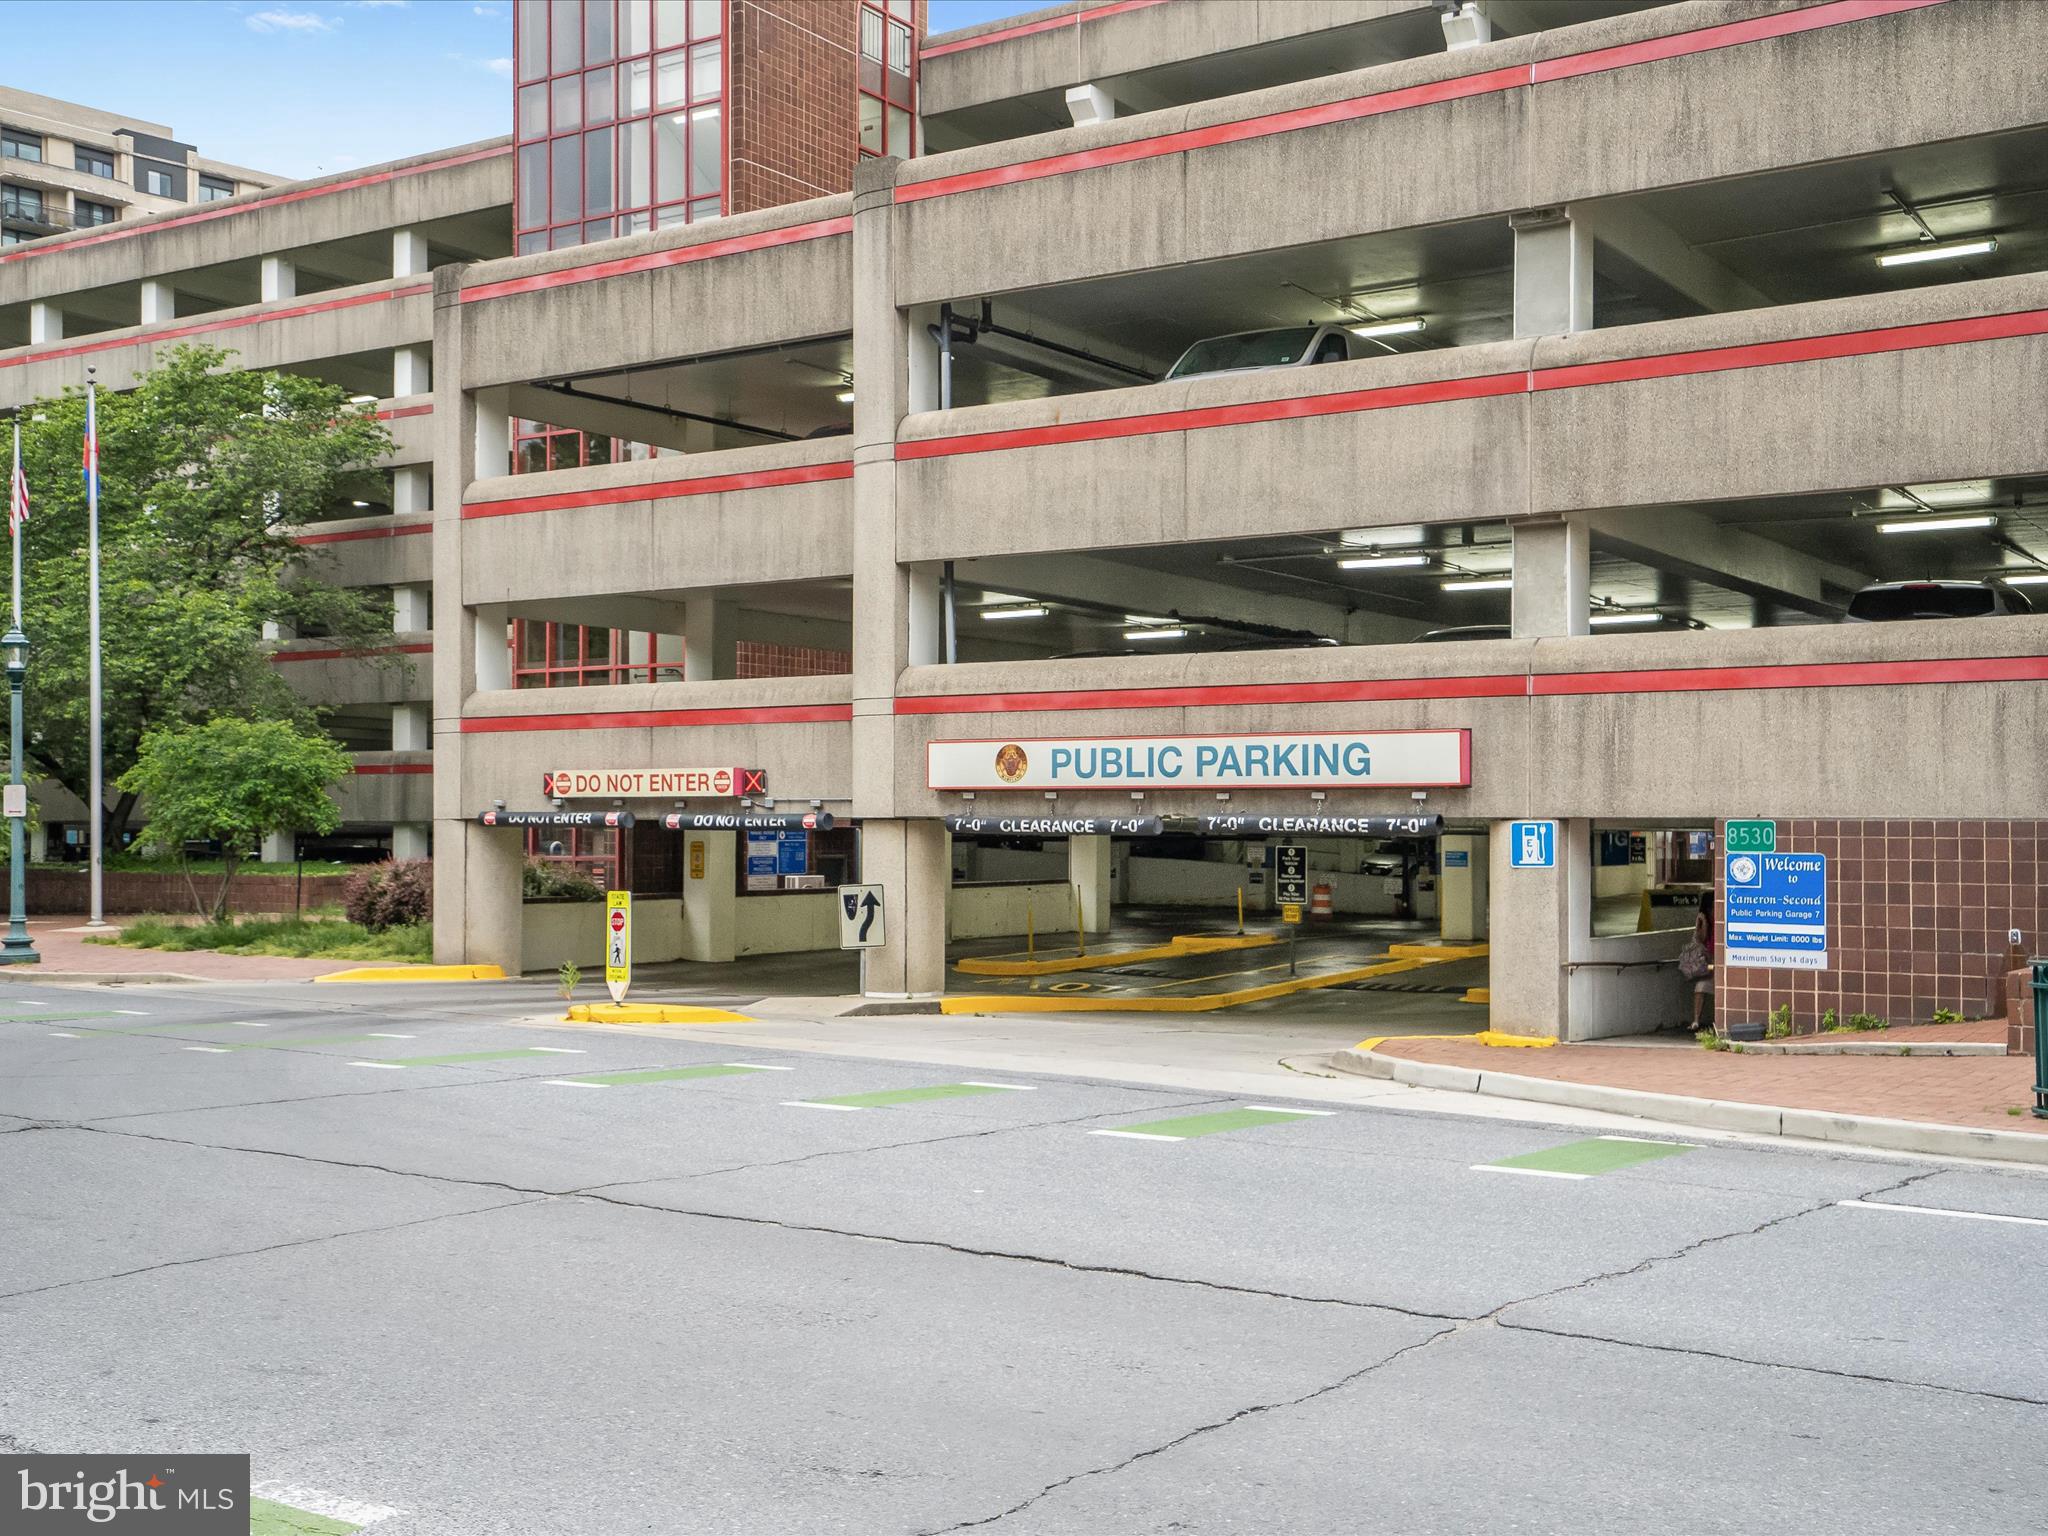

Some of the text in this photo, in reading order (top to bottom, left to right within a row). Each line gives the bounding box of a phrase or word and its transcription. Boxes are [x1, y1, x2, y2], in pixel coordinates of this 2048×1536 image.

[1051, 742, 1372, 779] PUBLIC PARKING
[576, 772, 710, 793] DO NOT ENTER
[554, 812, 592, 824] ENTER
[693, 814, 713, 827] DO
[954, 818, 1145, 833] 7'-0" CLEARANCE 7'-0"
[1258, 816, 1369, 833] CLEARANCE
[1386, 818, 1428, 833] 7'-0"
[1728, 827, 1774, 845] 8530
[1764, 856, 1821, 872] Welcome
[1788, 874, 1798, 884] to
[1673, 896, 1690, 905] Park
[1730, 908, 1820, 919] Public Parking Garage 7
[611, 918, 625, 926] STOP
[1746, 934, 1769, 943] Weight
[1771, 935, 1789, 943] Limit:
[1791, 935, 1810, 944] 8000
[1812, 936, 1823, 944] lbs
[1732, 954, 1818, 965] Maximum Stay 14 days
